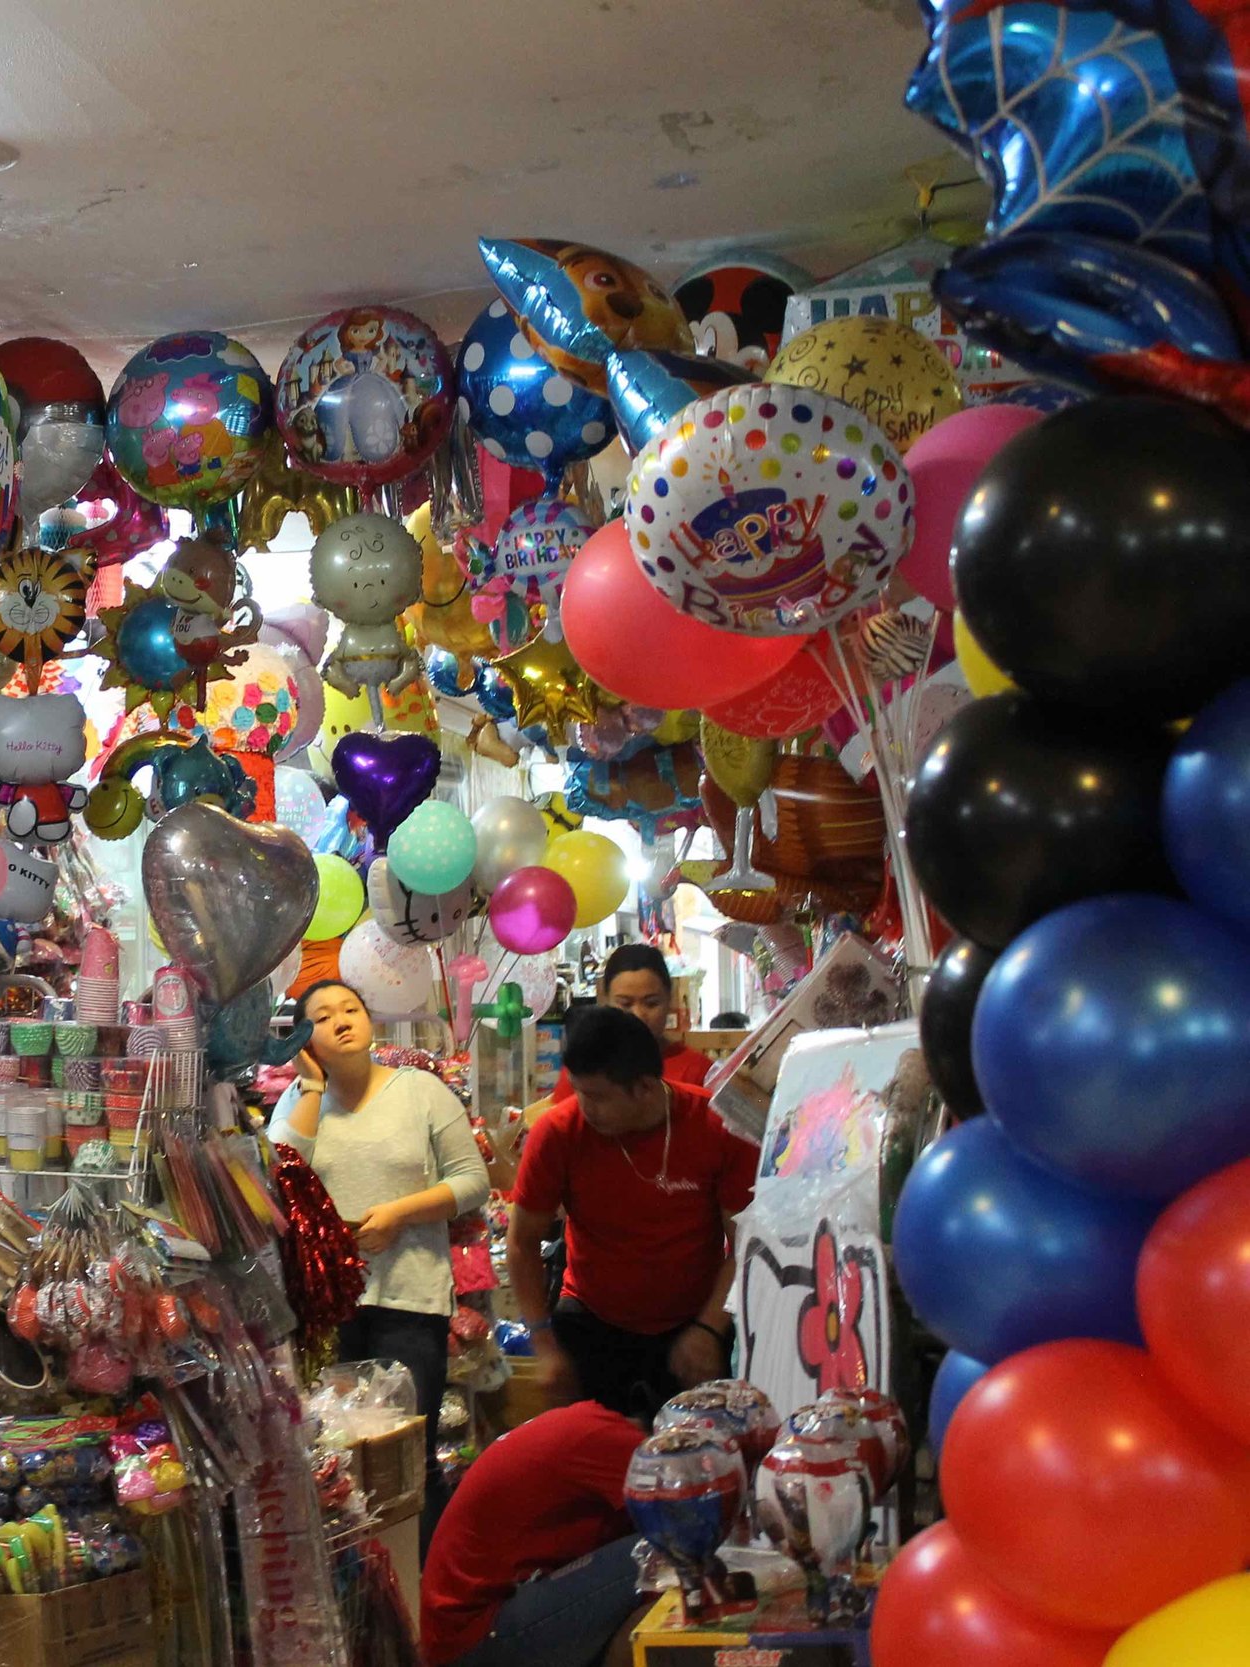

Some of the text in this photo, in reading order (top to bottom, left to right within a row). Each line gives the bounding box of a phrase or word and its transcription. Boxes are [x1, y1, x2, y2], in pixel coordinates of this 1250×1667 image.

[514, 528, 566, 551] HAPPY
[668, 493, 829, 571] Happy
[6, 740, 63, 756] Hello Kitty
[19, 865, 50, 889] KITTY
